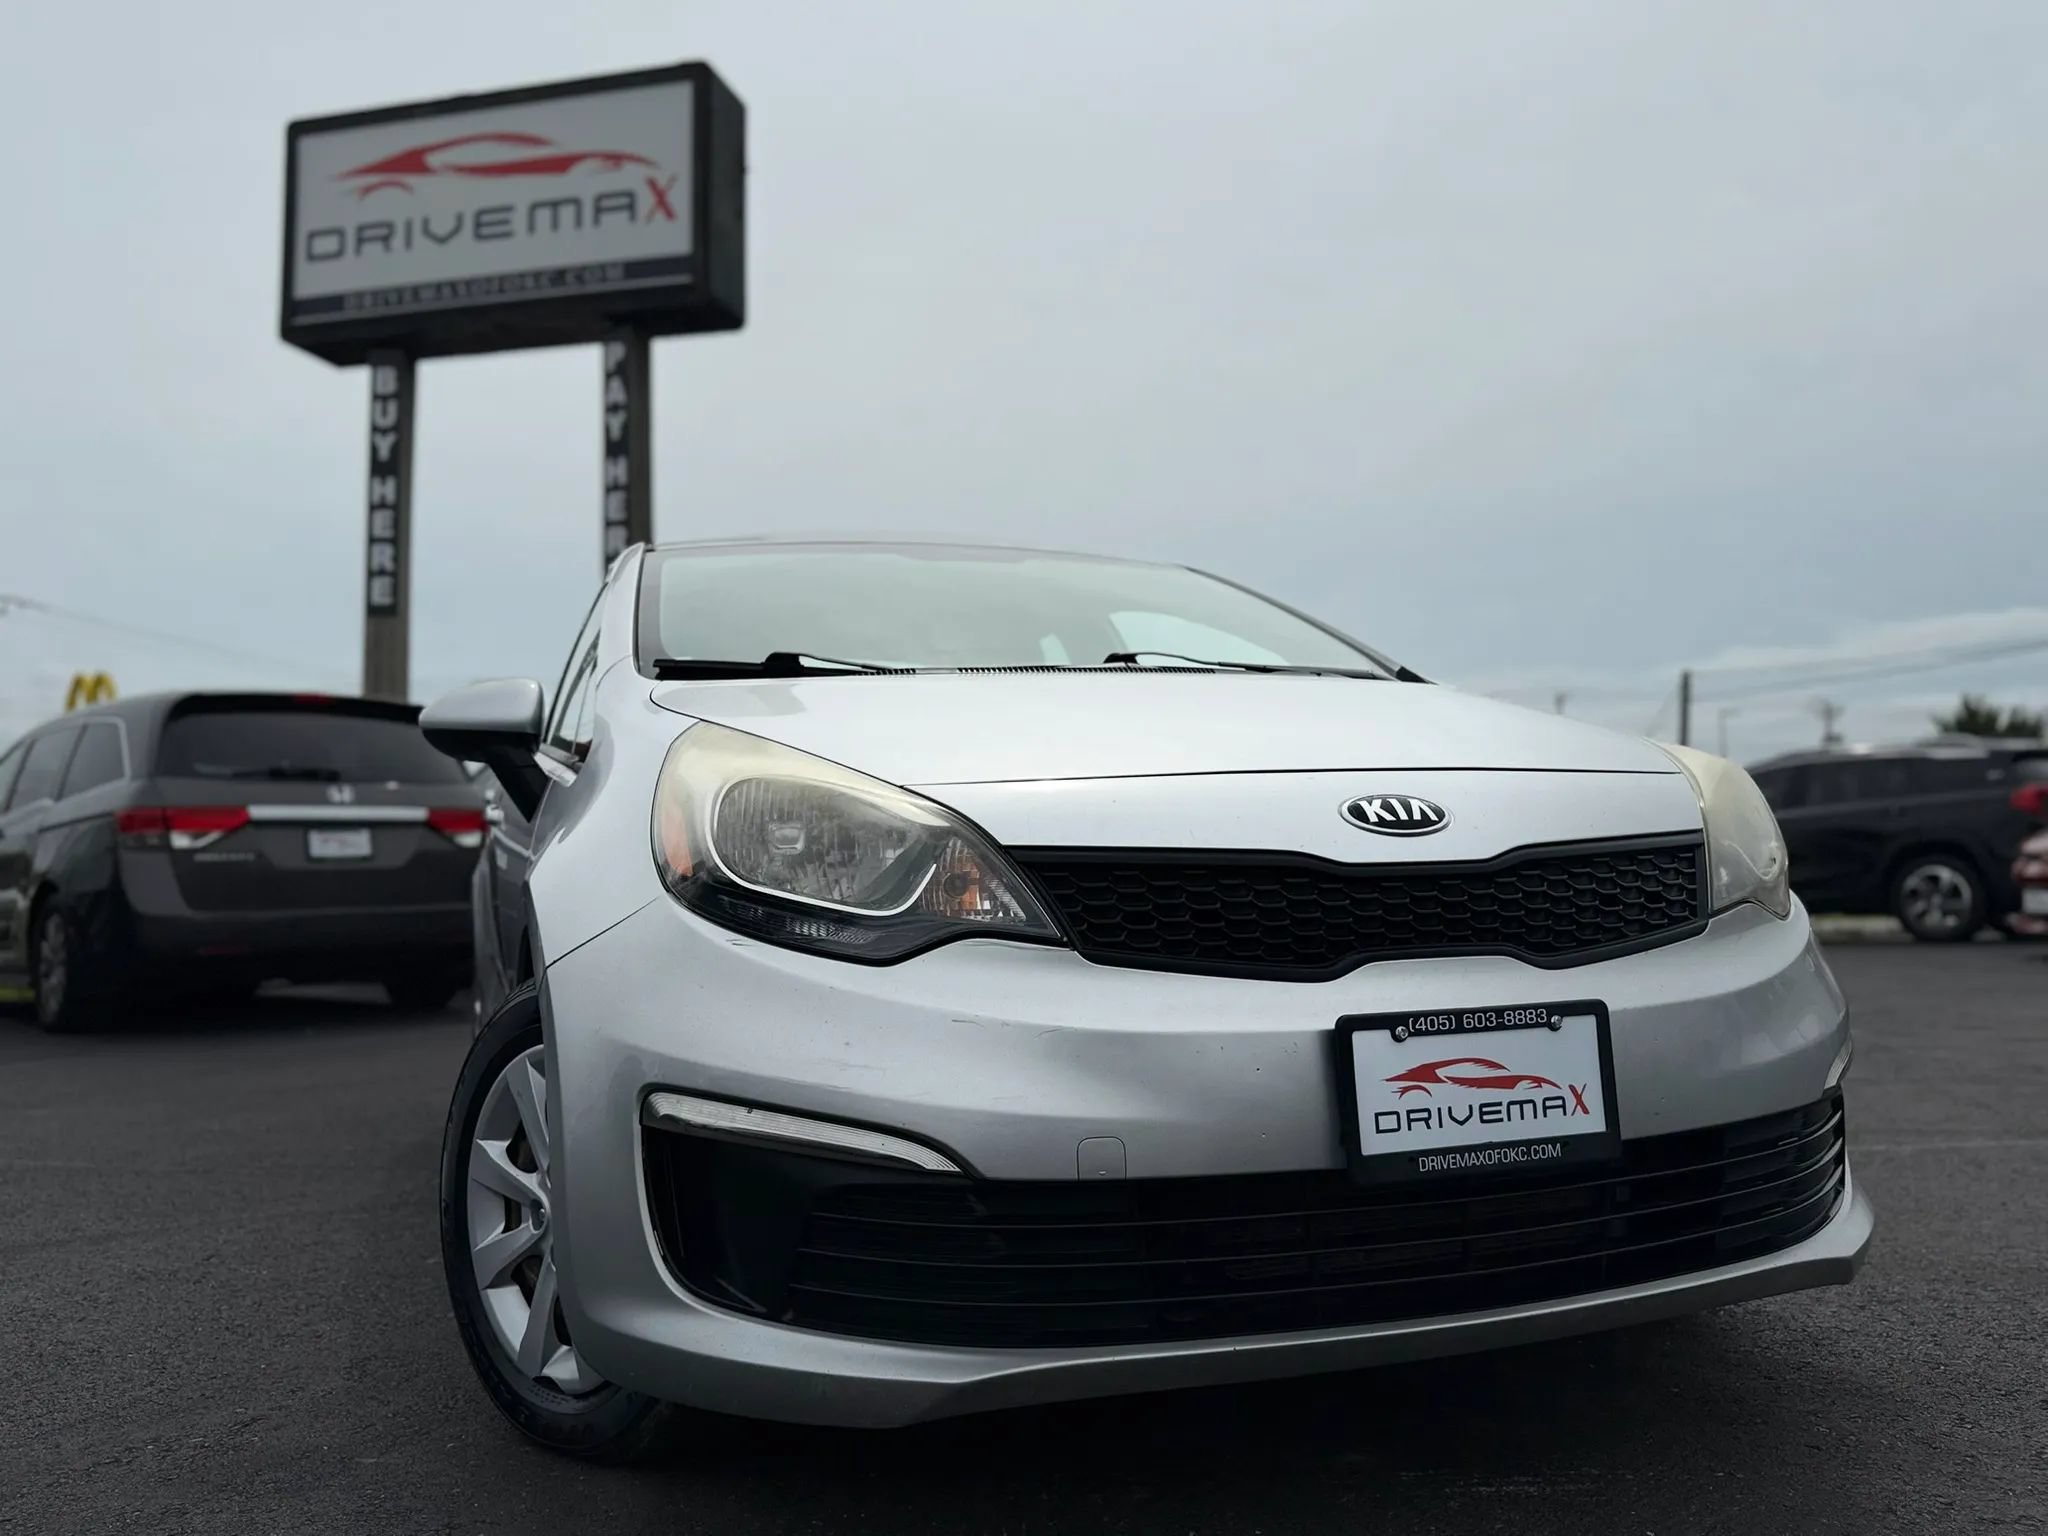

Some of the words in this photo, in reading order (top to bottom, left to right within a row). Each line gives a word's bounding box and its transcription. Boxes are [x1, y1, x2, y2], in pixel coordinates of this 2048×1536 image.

[305, 174, 676, 263] DRIVEMAX
[372, 366, 398, 462] BUY
[605, 341, 628, 443] PAY
[369, 475, 397, 606] HERE
[605, 454, 629, 557] HER
[1356, 797, 1440, 823] KIA
[1409, 1013, 1456, 1032] (405)
[1463, 1008, 1548, 1029] 603-8883
[1374, 1083, 1590, 1134] DRIVEMAX
[1418, 1143, 1562, 1172] DRIVEMAXOFOKC.COM
